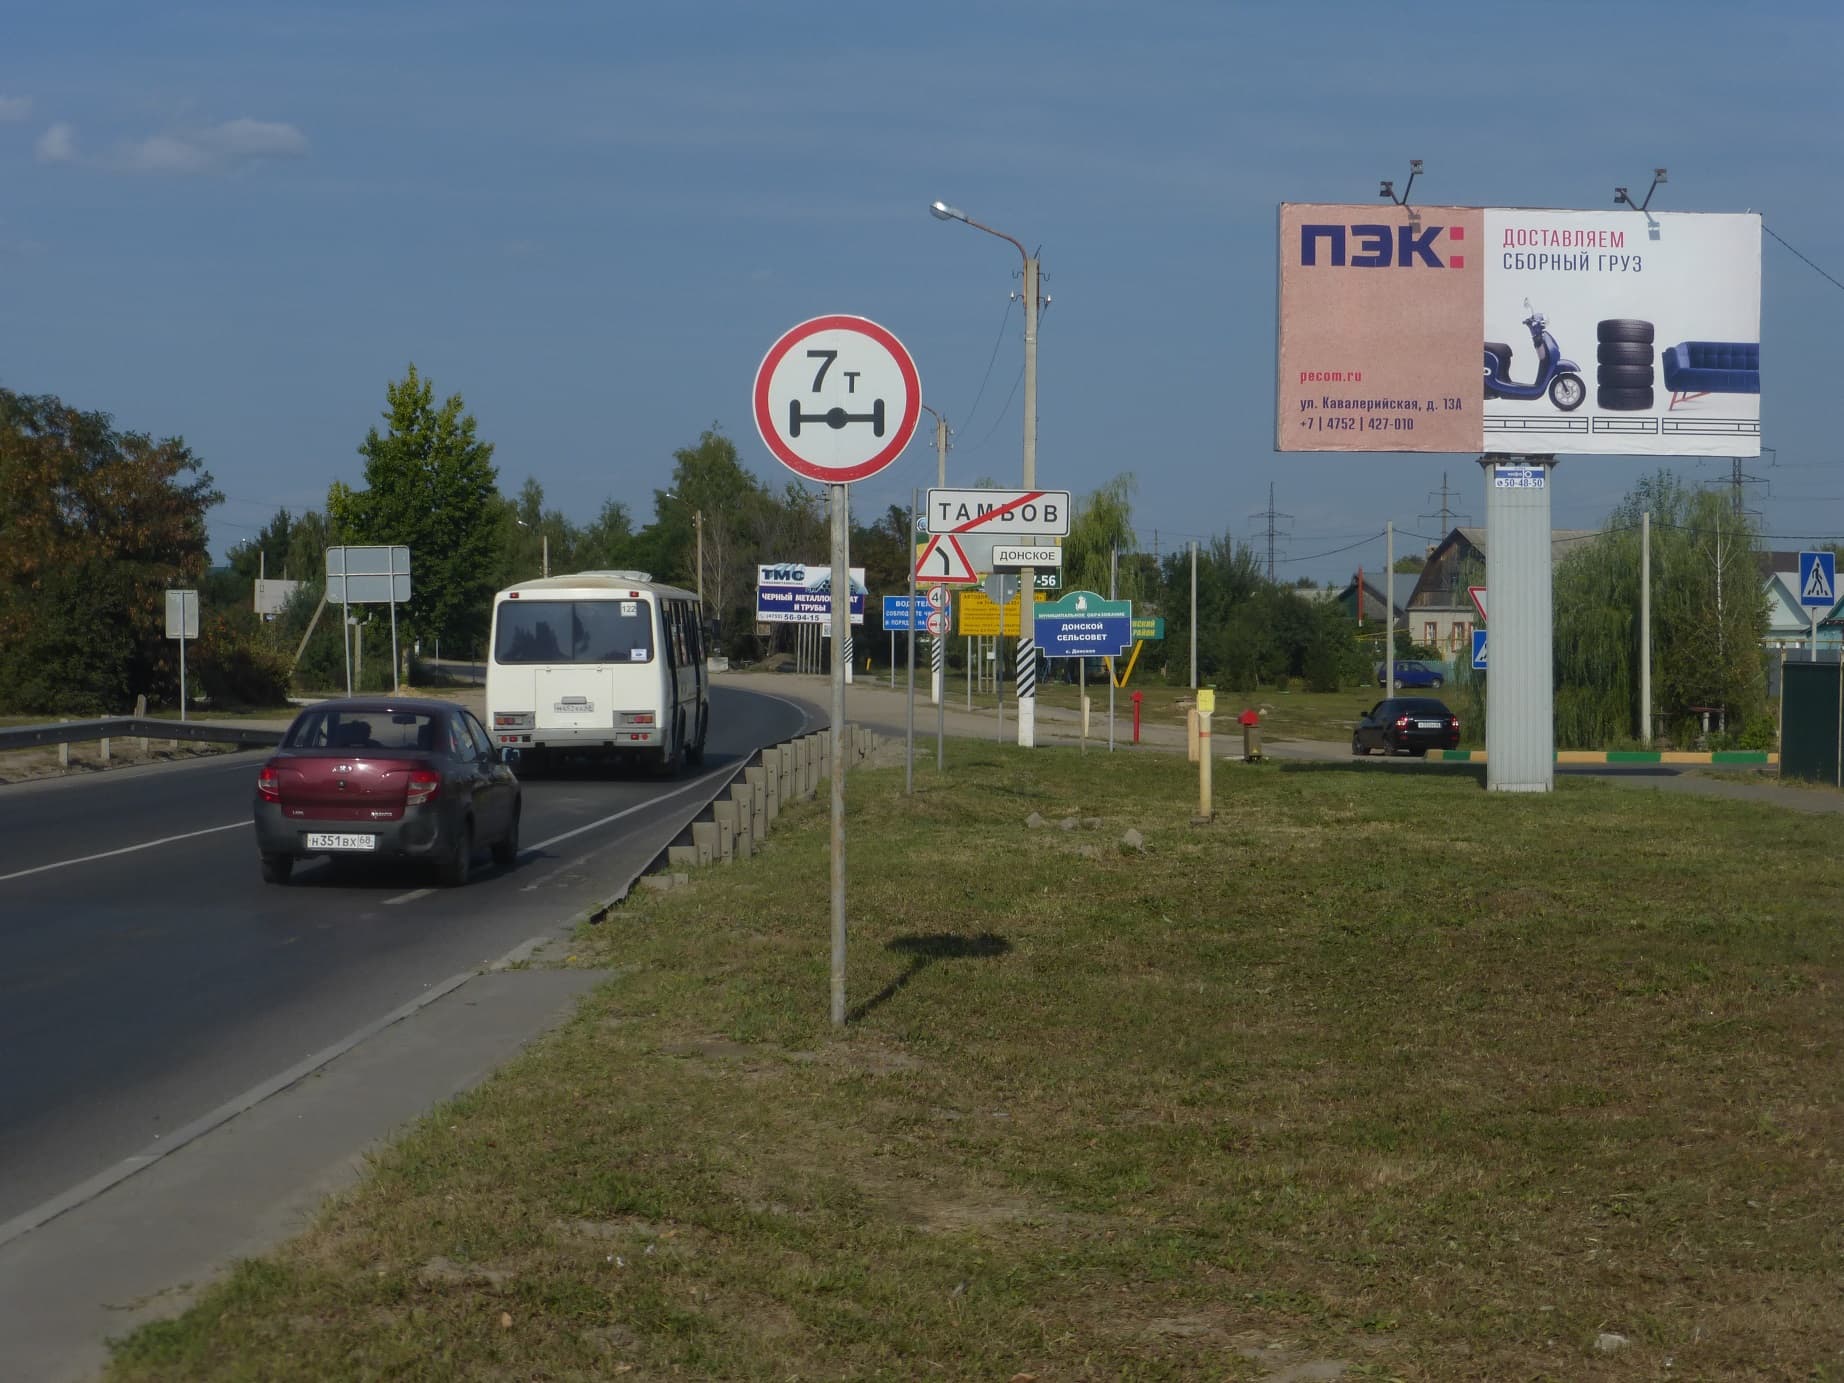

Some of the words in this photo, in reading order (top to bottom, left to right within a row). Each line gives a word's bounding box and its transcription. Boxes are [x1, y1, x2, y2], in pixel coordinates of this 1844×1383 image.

[1503, 228, 1624, 248] ДОСТАВЛЯЕМ
[1503, 251, 1590, 272] СБОРНЫЙ
[1598, 254, 1642, 272] ГРУЗ
[807, 350, 837, 392] 7
[1300, 371, 1362, 384] pecom.ru
[1300, 399, 1318, 411] ул.
[1322, 396, 1422, 412] Кавалерийская,
[1426, 401, 1438, 412] д.
[1443, 398, 1463, 410] 13А
[1300, 418, 1313, 430] +7
[1327, 417, 1355, 430] 4752
[1368, 417, 1414, 430] 427-010
[1504, 478, 1543, 487] 50-48-50
[938, 503, 1058, 522] ТАМБОВ
[1000, 550, 1056, 561] ДОНСКОЕ
[761, 568, 805, 581] ТМС
[761, 592, 793, 601] ЧЕРНЫЙ
[622, 605, 637, 613] 122
[801, 604, 826, 612] ТРУБЫ
[784, 613, 820, 621] 56-94-15
[1061, 621, 1104, 632] ДОНСКОЙ
[1056, 633, 1108, 641] СЕЛЬСОВЕТ
[311, 835, 357, 847] Н351ВХ
[359, 835, 371, 845] 68
